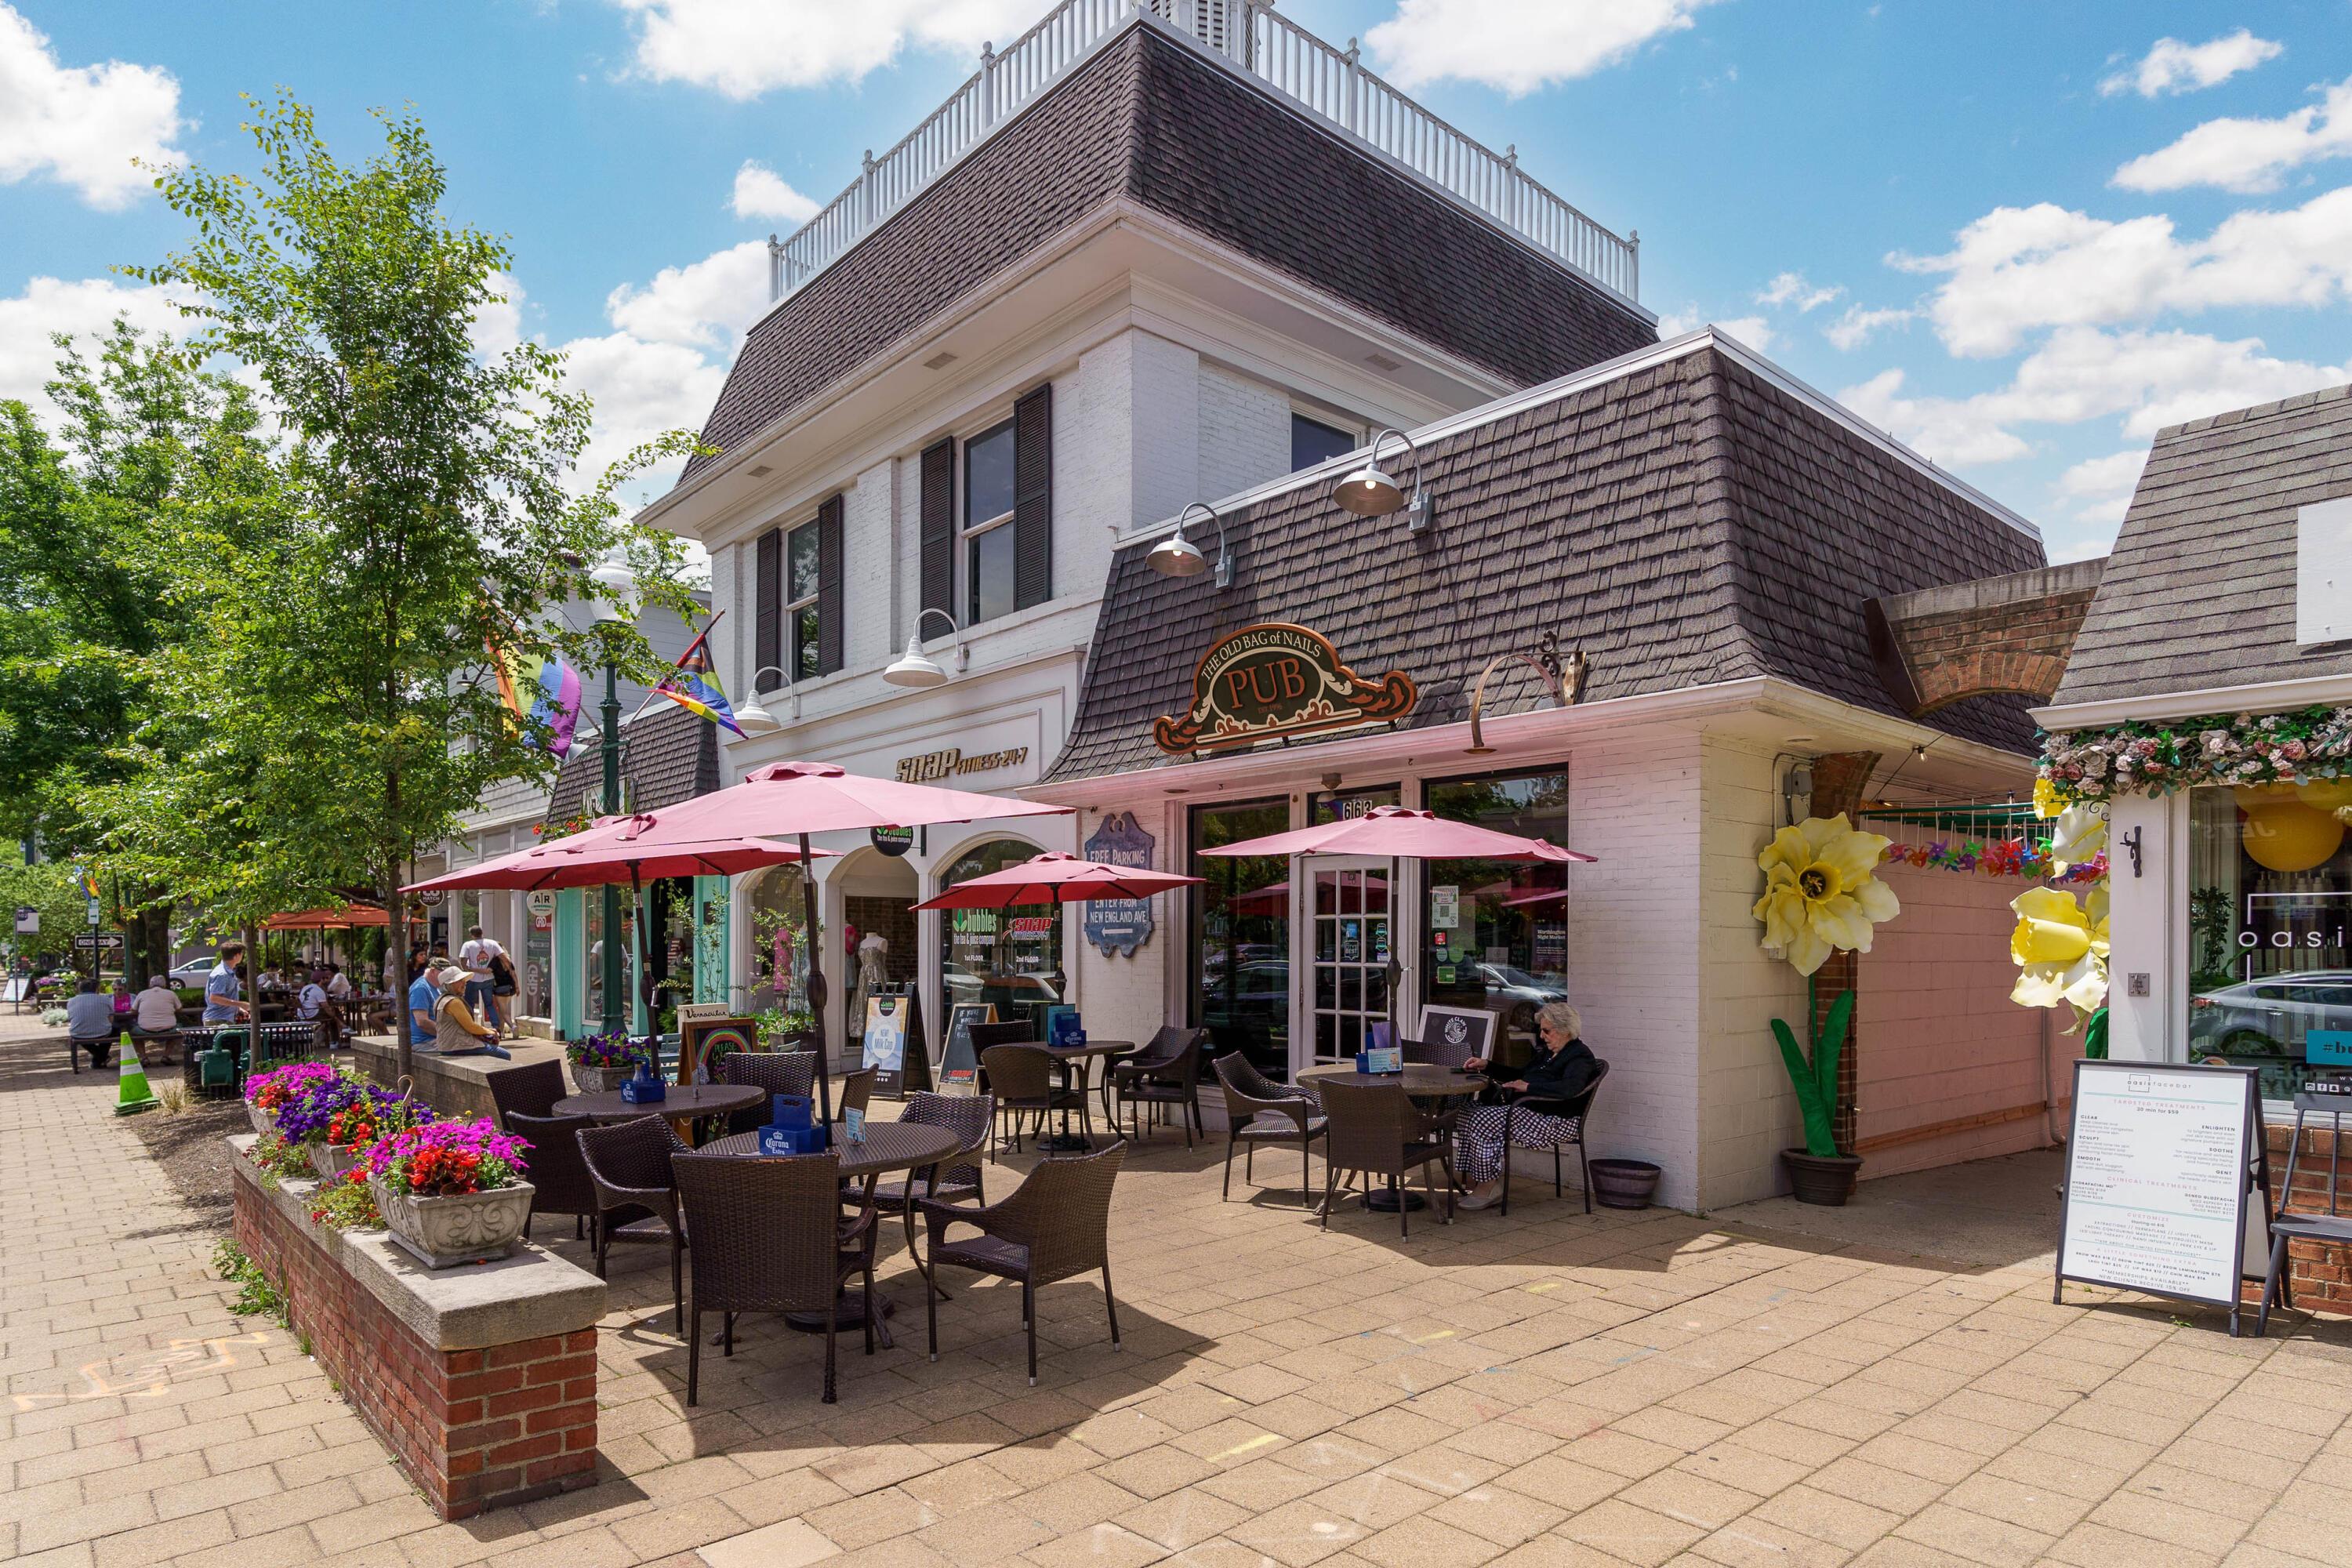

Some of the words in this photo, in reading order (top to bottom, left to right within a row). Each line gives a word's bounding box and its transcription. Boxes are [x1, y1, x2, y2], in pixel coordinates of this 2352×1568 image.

[1201, 659, 1221, 681] THE
[1220, 641, 1242, 662] OLD
[1244, 631, 1268, 649] BAG
[1270, 631, 1282, 645] of
[1283, 631, 1322, 658] NAILS
[1224, 658, 1306, 709] PUB
[1112, 849, 1145, 865] PARKING
[1095, 899, 1117, 908] ENTER
[1120, 899, 1137, 908] FROM
[967, 909, 996, 932] bubbles
[1090, 911, 1103, 923] NEW
[1105, 911, 1132, 923] ENGLAND
[1014, 918, 1052, 932] snap
[966, 933, 969, 945] &
[970, 933, 979, 946] juice
[979, 935, 995, 946] company
[1445, 1018, 1454, 1033] WHITE
[1455, 1016, 1466, 1026] CLAW
[714, 1043, 737, 1051] PLEASE
[874, 1039, 884, 1049] Milk
[2155, 1102, 2205, 1110] TREATMENTS
[765, 1138, 789, 1149] Corona
[772, 1146, 785, 1155] Extra
[2107, 1175, 2142, 1184] CLINICAL
[2146, 1180, 2197, 1190] TREATMENTS
[2127, 1212, 2168, 1222] CUSTOMIZE
[2178, 1267, 2209, 1275] LAMINATION
[2113, 1276, 2136, 1284] CLIENTS
